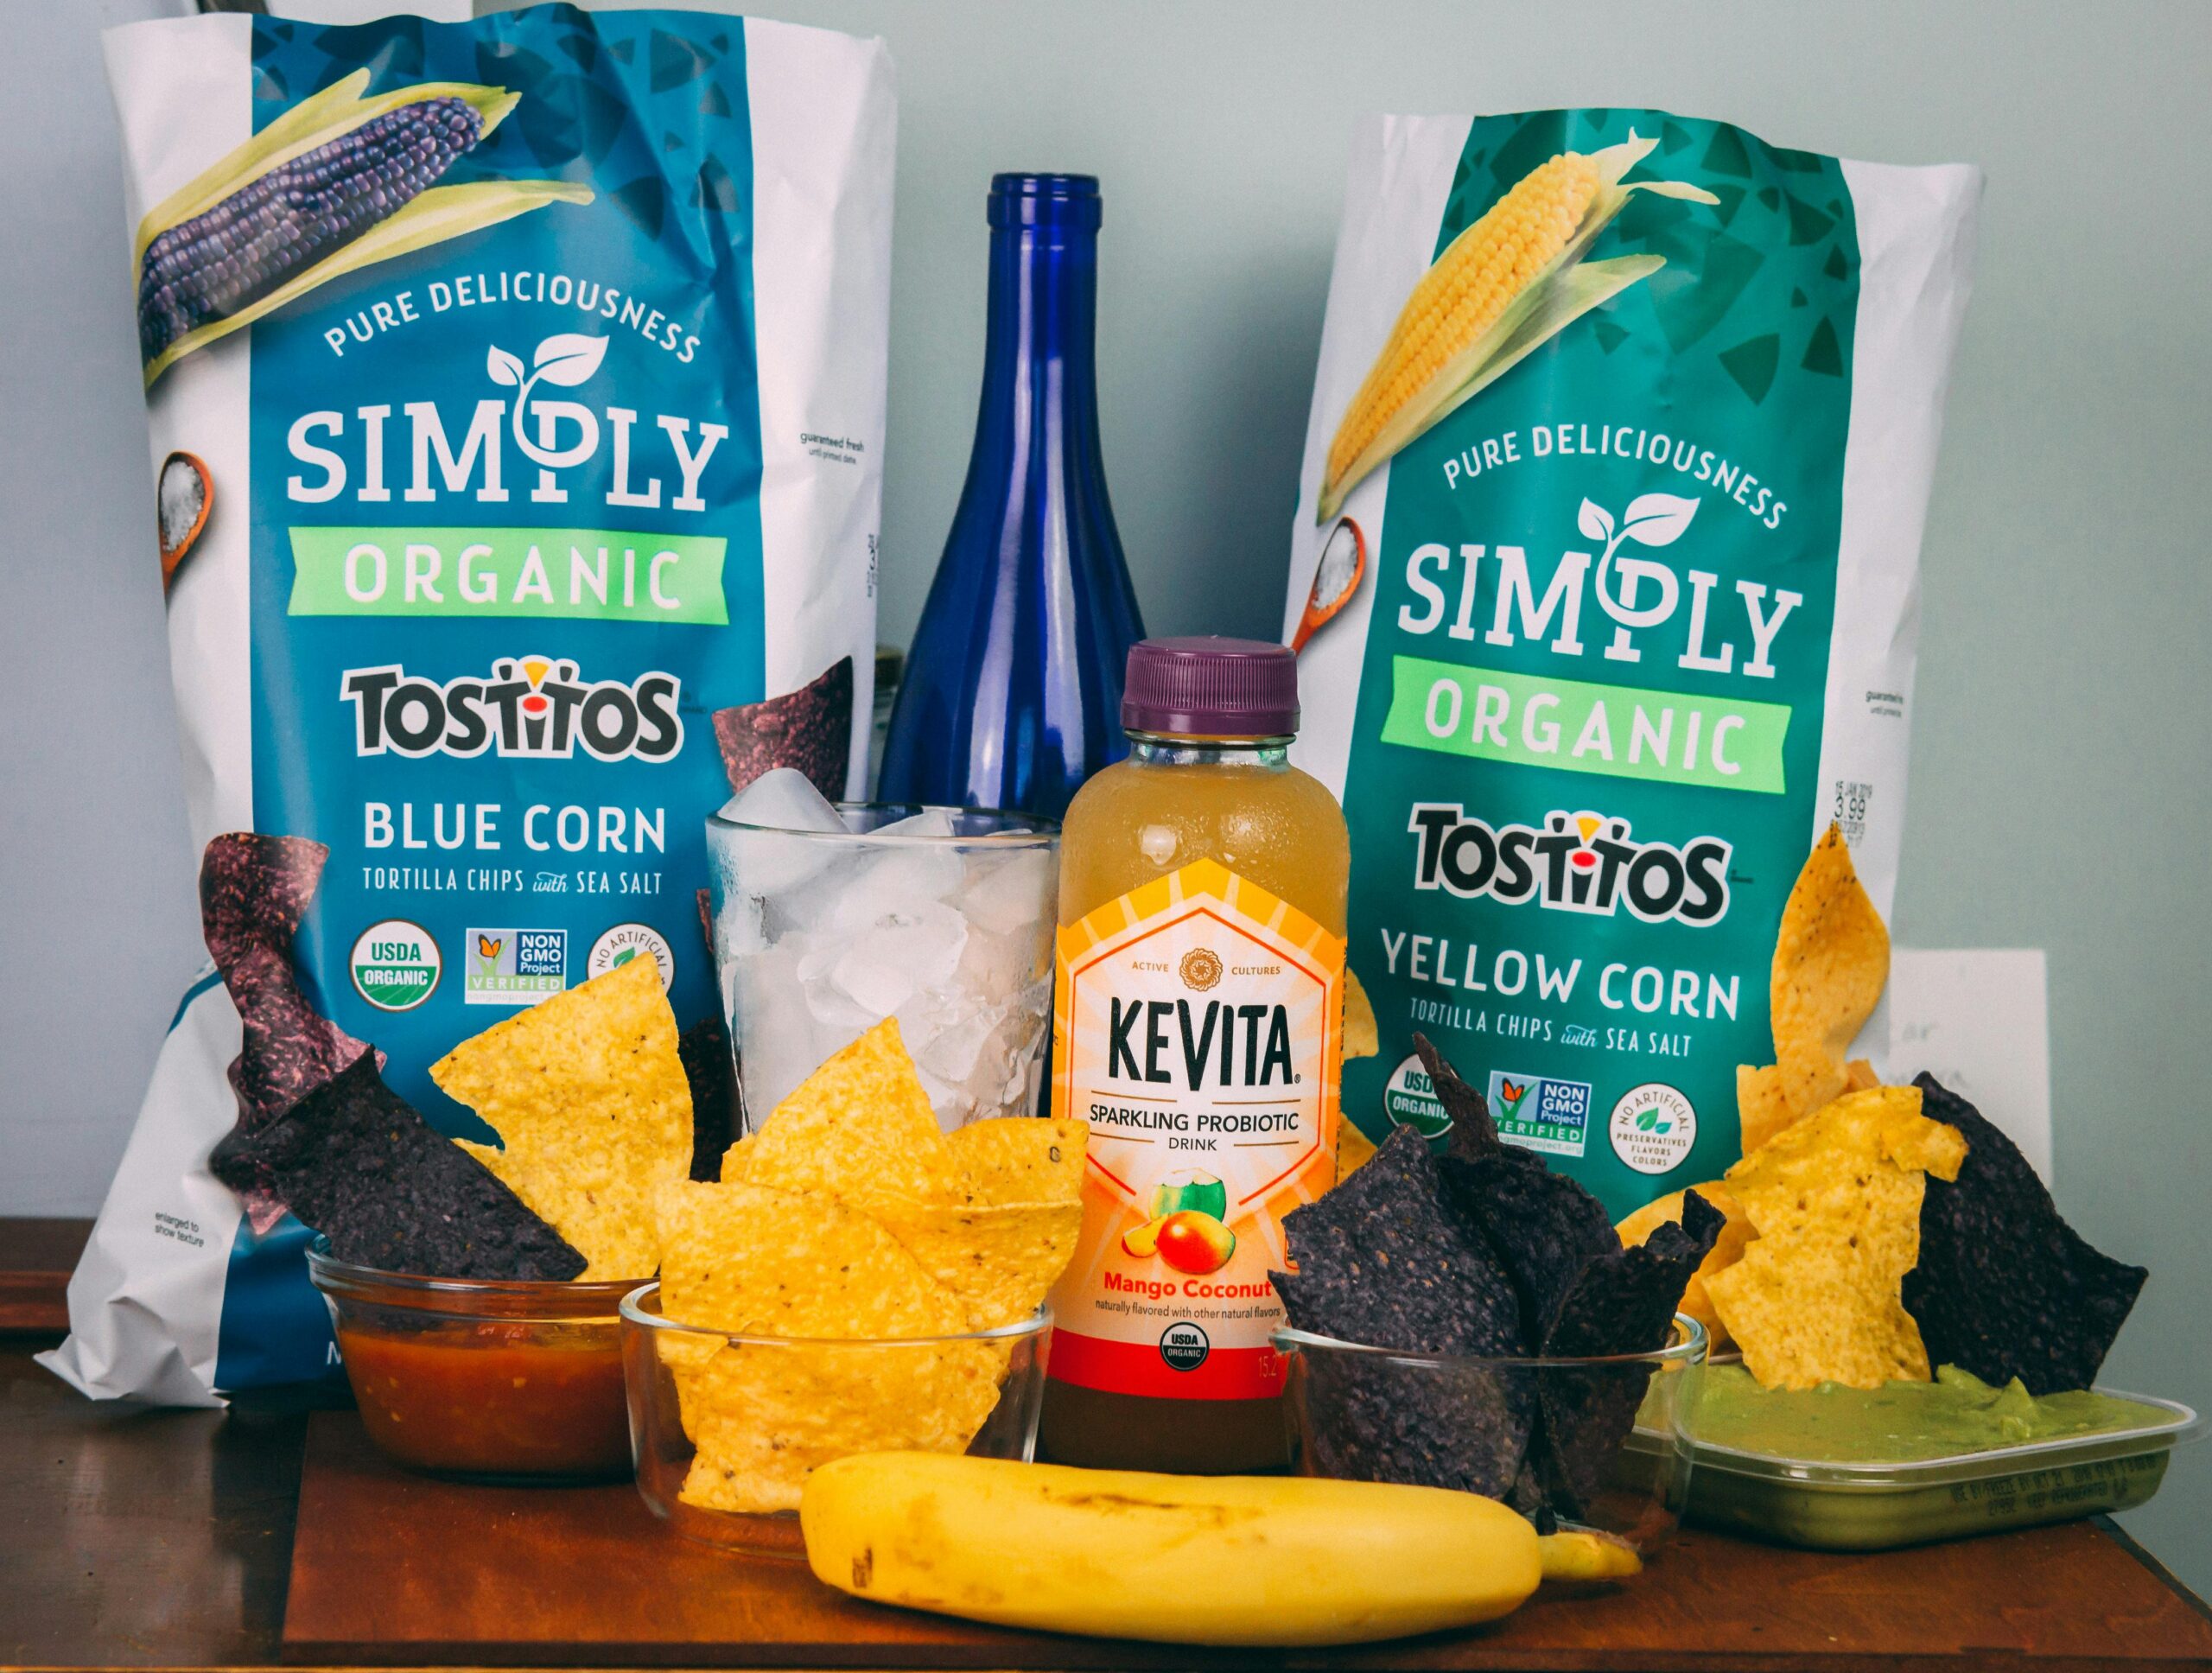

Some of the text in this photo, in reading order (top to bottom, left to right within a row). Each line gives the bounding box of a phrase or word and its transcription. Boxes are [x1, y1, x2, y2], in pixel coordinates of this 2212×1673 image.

[324, 271, 701, 363] PURE DELICIOUSNESS
[800, 433, 844, 448] guaranteed
[287, 396, 729, 512] SIMPLY
[1443, 424, 1788, 529] PURE DELICIOUSNESS
[344, 543, 682, 609] ORGANIC
[1398, 542, 1803, 679] SIMPLY
[1425, 678, 1746, 776] ORGANIC
[1834, 795, 1866, 820] 3.99
[365, 802, 665, 854] BLUE CORN
[363, 867, 662, 894] TORTILLA CHIPS with SEA SALT
[521, 934, 561, 949] NON
[372, 942, 422, 962] USDA
[521, 949, 562, 963] GMO
[596, 949, 610, 968] NO
[364, 969, 428, 986] ORGANIC
[521, 963, 561, 976] Project
[1132, 960, 1281, 975] ACTIVE CULTURES
[1381, 928, 1740, 1021] YELLOW CORN
[472, 977, 561, 990] VERIFIED
[1411, 997, 1691, 1058] TORTILLA CHIPS with SEA SALT
[1109, 996, 1294, 1091] KEVITA
[1404, 1071, 1434, 1093] USD
[1544, 1084, 1585, 1101] NON
[1542, 1097, 1584, 1115] GMO
[1618, 1091, 1689, 1132] NO ARTIFICIAL
[1090, 1104, 1300, 1133] SPARKLING PROBIOTIC
[1541, 1110, 1581, 1125] Project
[1168, 1137, 1217, 1151] DRINK
[1617, 1133, 1687, 1147] PRESERVATIVES
[1631, 1145, 1671, 1156] FLAVORS
[1632, 1156, 1668, 1167] COLORS
[155, 1212, 200, 1232] enlarged to
[155, 1224, 205, 1248] show texture
[1104, 1272, 1272, 1301] Mango Coconut
[1096, 1299, 1281, 1320] naturally flavored with other natural flavors
[1171, 1333, 1198, 1345] USDA
[1167, 1347, 1201, 1358] ORGANIC
[1258, 1353, 1277, 1377] 15.2
